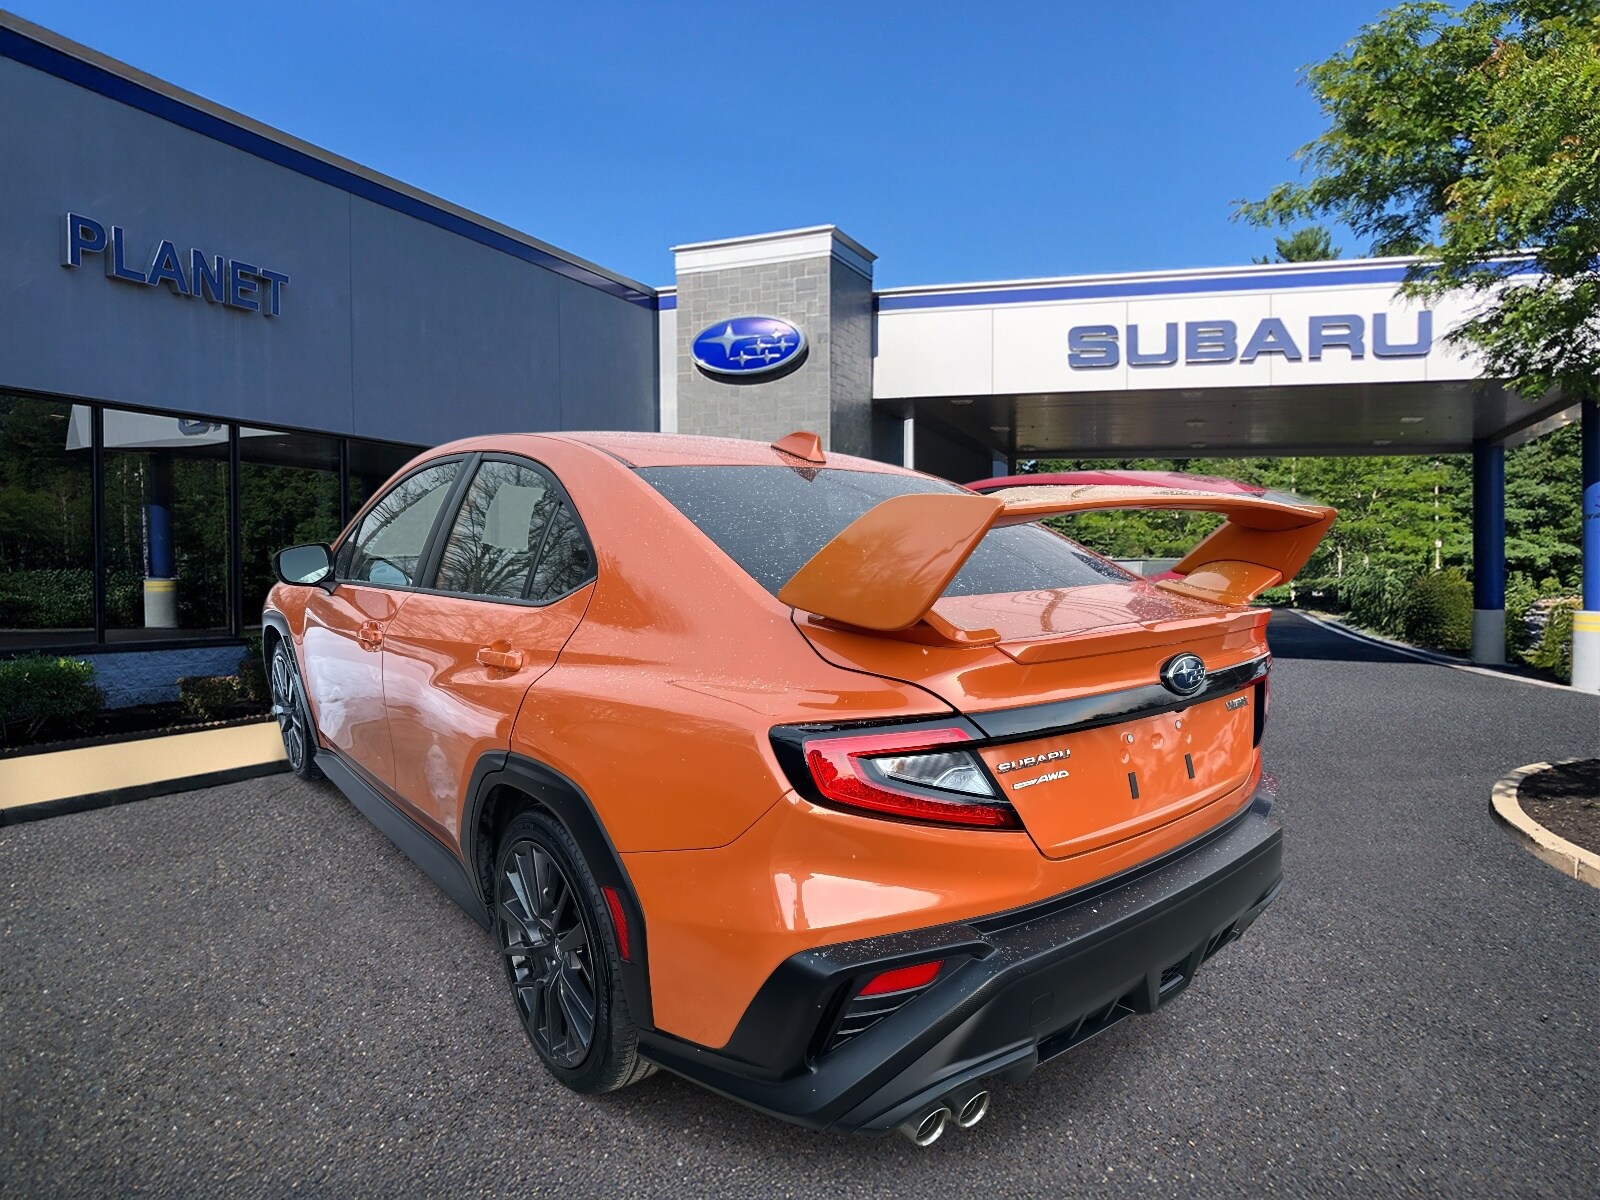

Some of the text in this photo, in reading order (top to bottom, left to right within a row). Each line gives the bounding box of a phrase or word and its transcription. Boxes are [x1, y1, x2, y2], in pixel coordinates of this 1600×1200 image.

[64, 212, 291, 317] PLANET
[1067, 310, 1433, 370] SUBARU
[996, 748, 1071, 774] SUBARU
